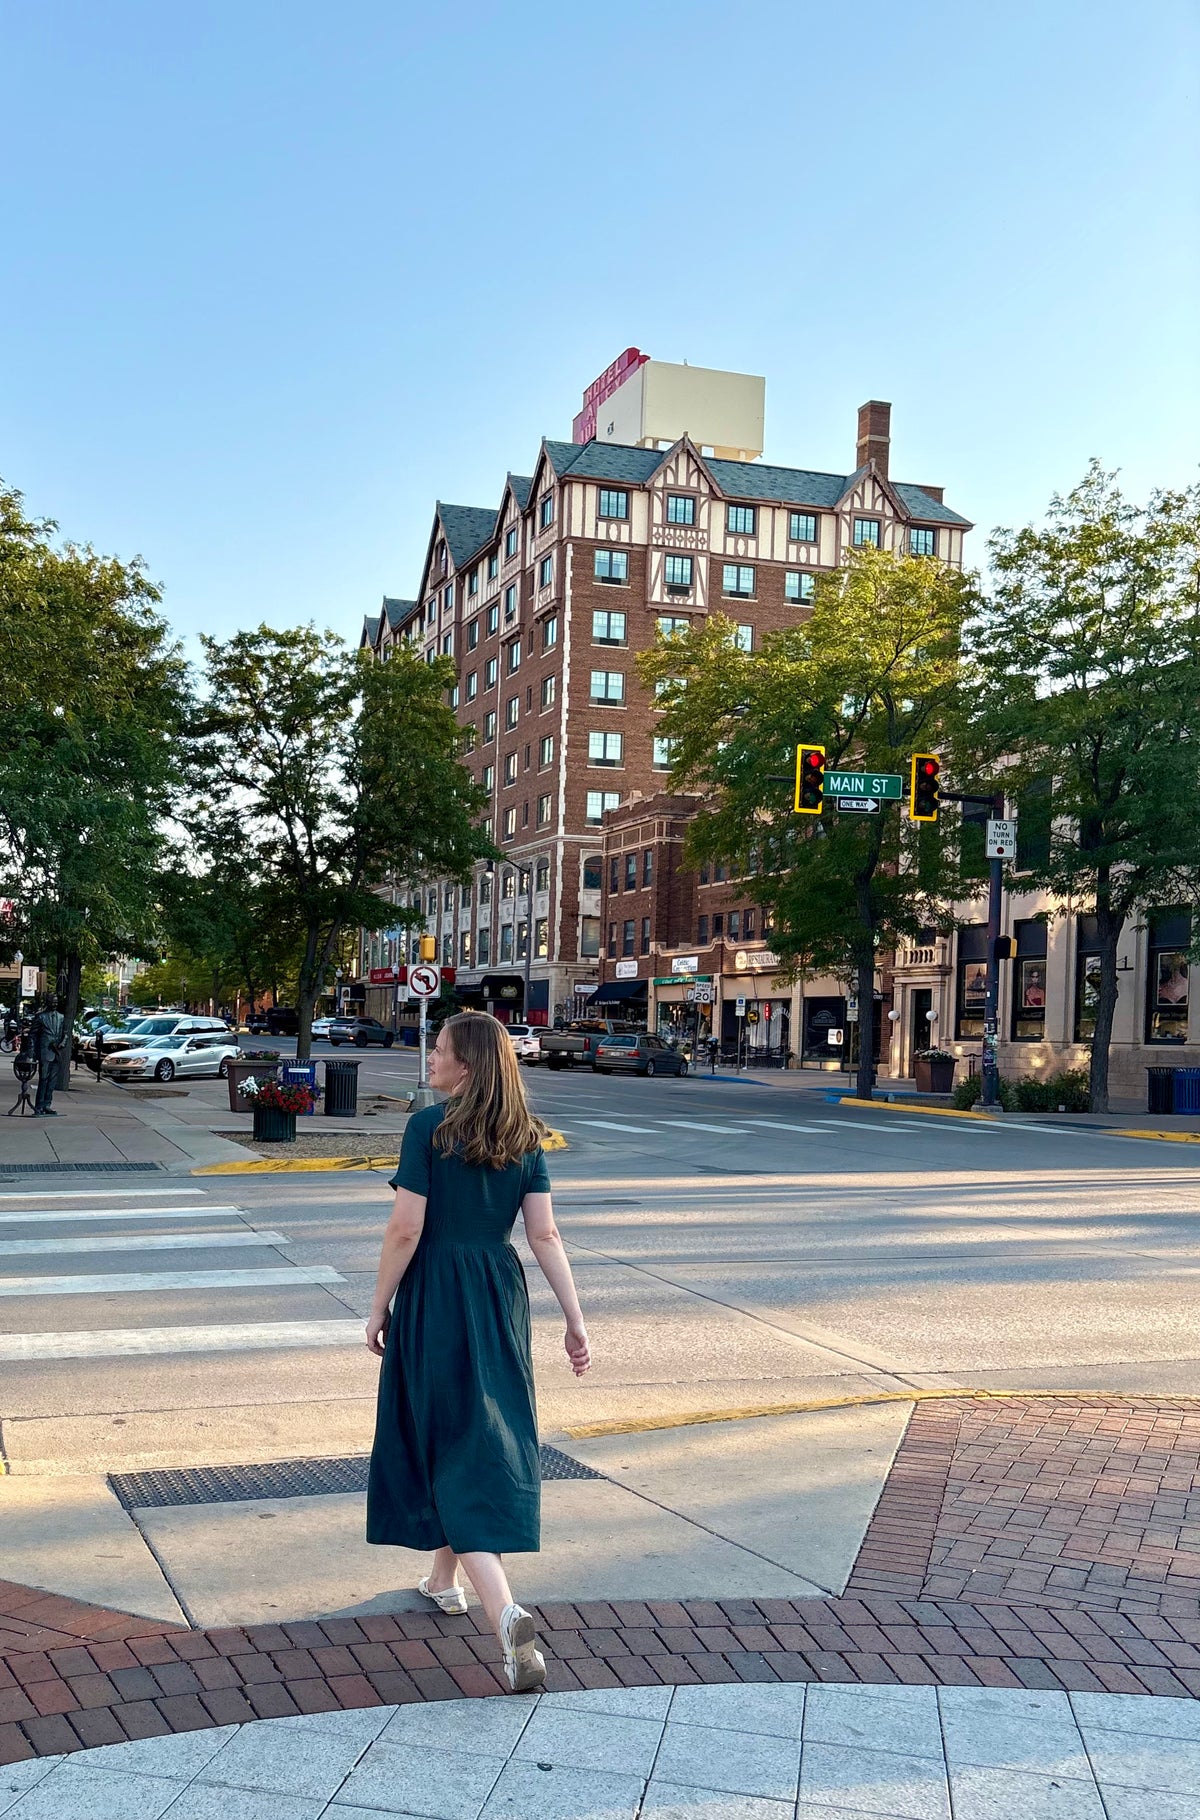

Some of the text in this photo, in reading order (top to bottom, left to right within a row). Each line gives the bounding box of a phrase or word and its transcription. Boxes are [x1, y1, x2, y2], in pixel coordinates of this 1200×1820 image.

[586, 360, 622, 404] HOTEL
[829, 776, 889, 794] MAIN ST
[994, 822, 1008, 831] NO
[993, 831, 1010, 839] TURN
[988, 838, 1013, 847] ON RED
[695, 992, 709, 1001] 20
